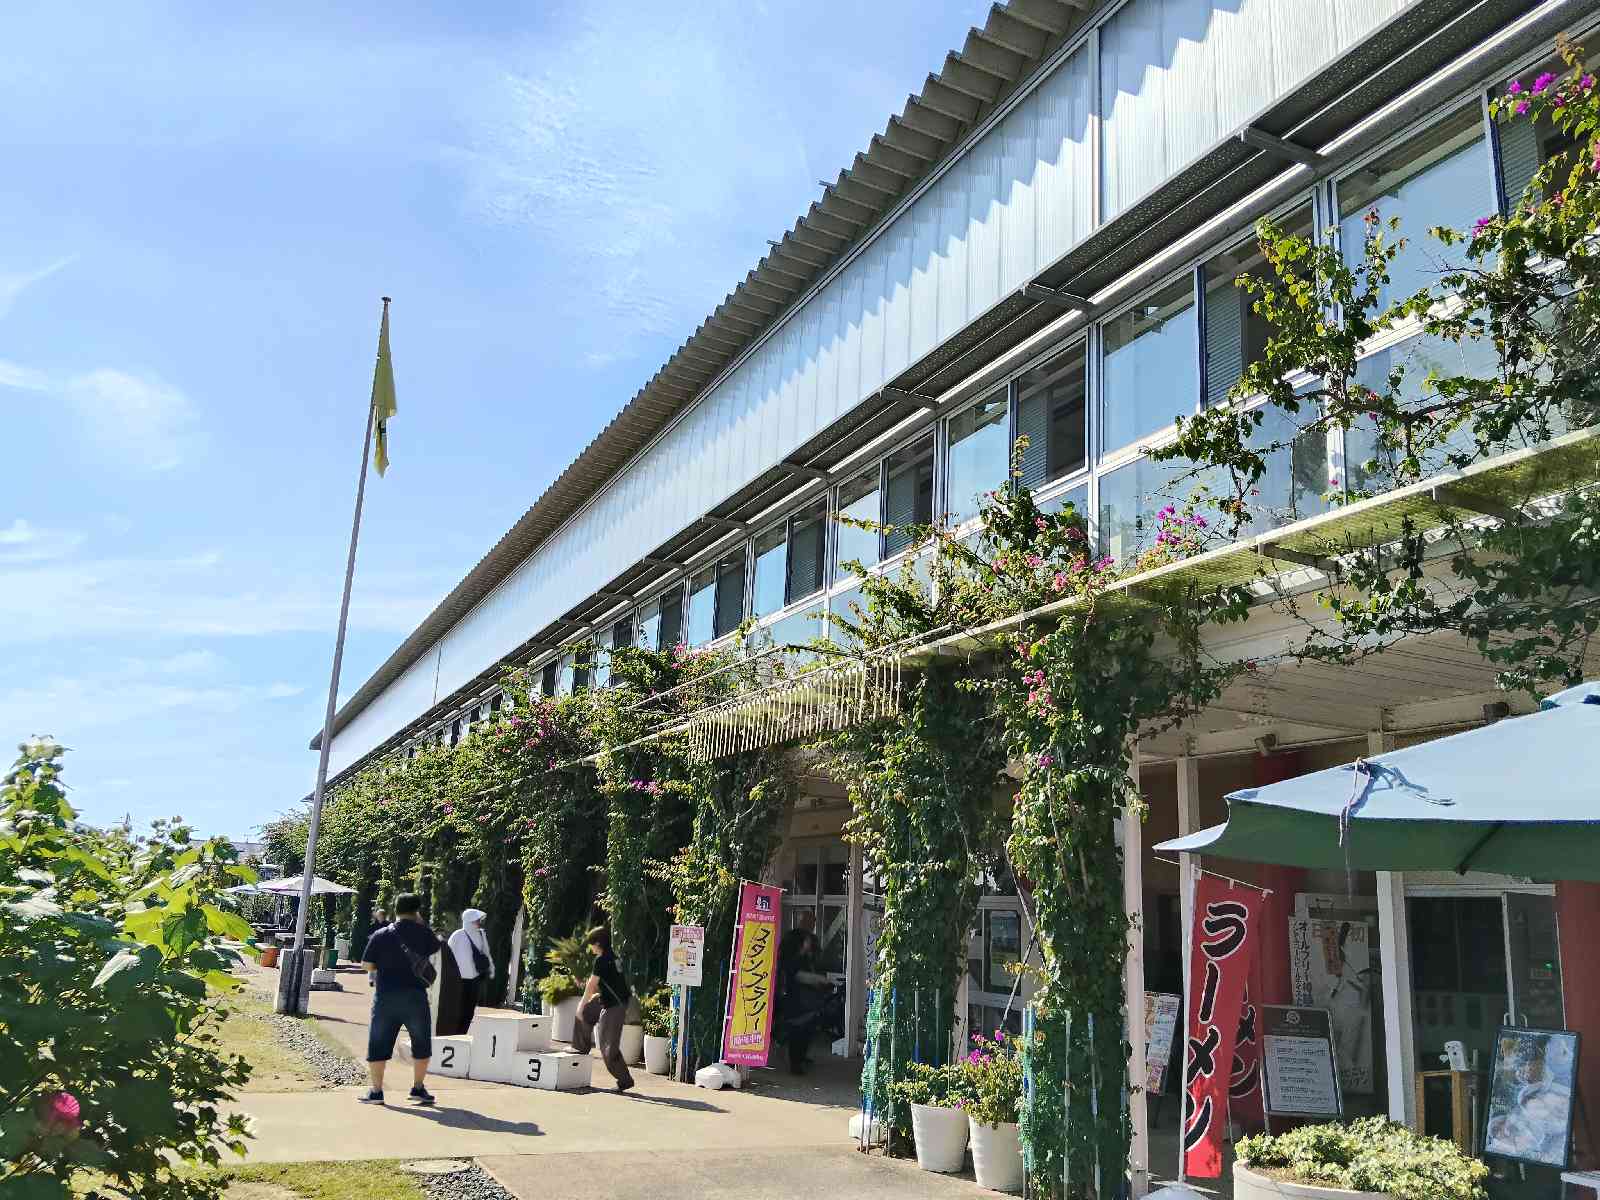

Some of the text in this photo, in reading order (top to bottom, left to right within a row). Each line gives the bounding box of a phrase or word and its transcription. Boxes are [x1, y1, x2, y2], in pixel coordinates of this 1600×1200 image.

[740, 928, 771, 1030] スタンプラリー
[1184, 901, 1248, 1152] ラーメン
[441, 1046, 455, 1068] 2
[491, 1034, 497, 1058] 1
[527, 1059, 542, 1081] 3
